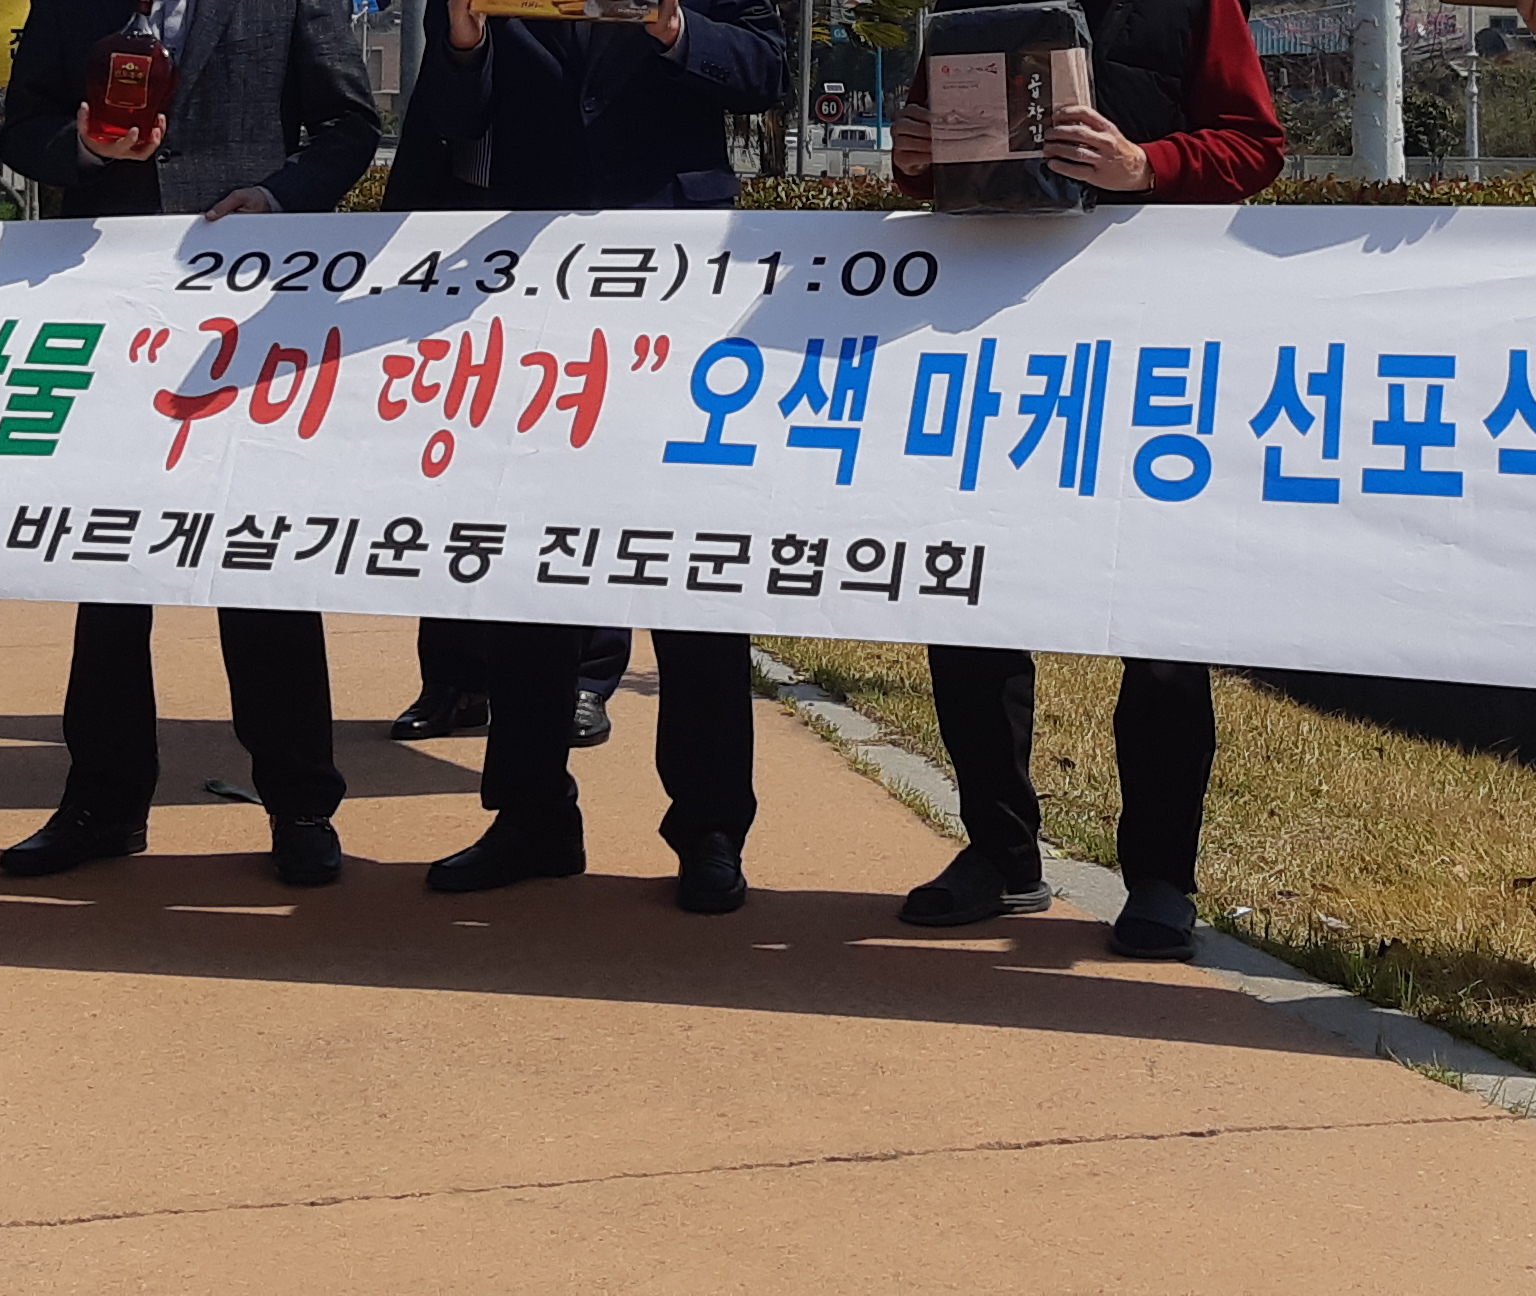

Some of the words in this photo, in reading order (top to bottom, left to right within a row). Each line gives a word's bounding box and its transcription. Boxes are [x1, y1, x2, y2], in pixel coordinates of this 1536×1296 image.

[821, 101, 837, 116] 60
[1027, 73, 1046, 143] 곱창김
[662, 333, 879, 487] 오색
[903, 336, 1221, 503] 마케팅
[5, 504, 509, 586] 바르게살기운동
[535, 527, 987, 607] 진도군협의회
